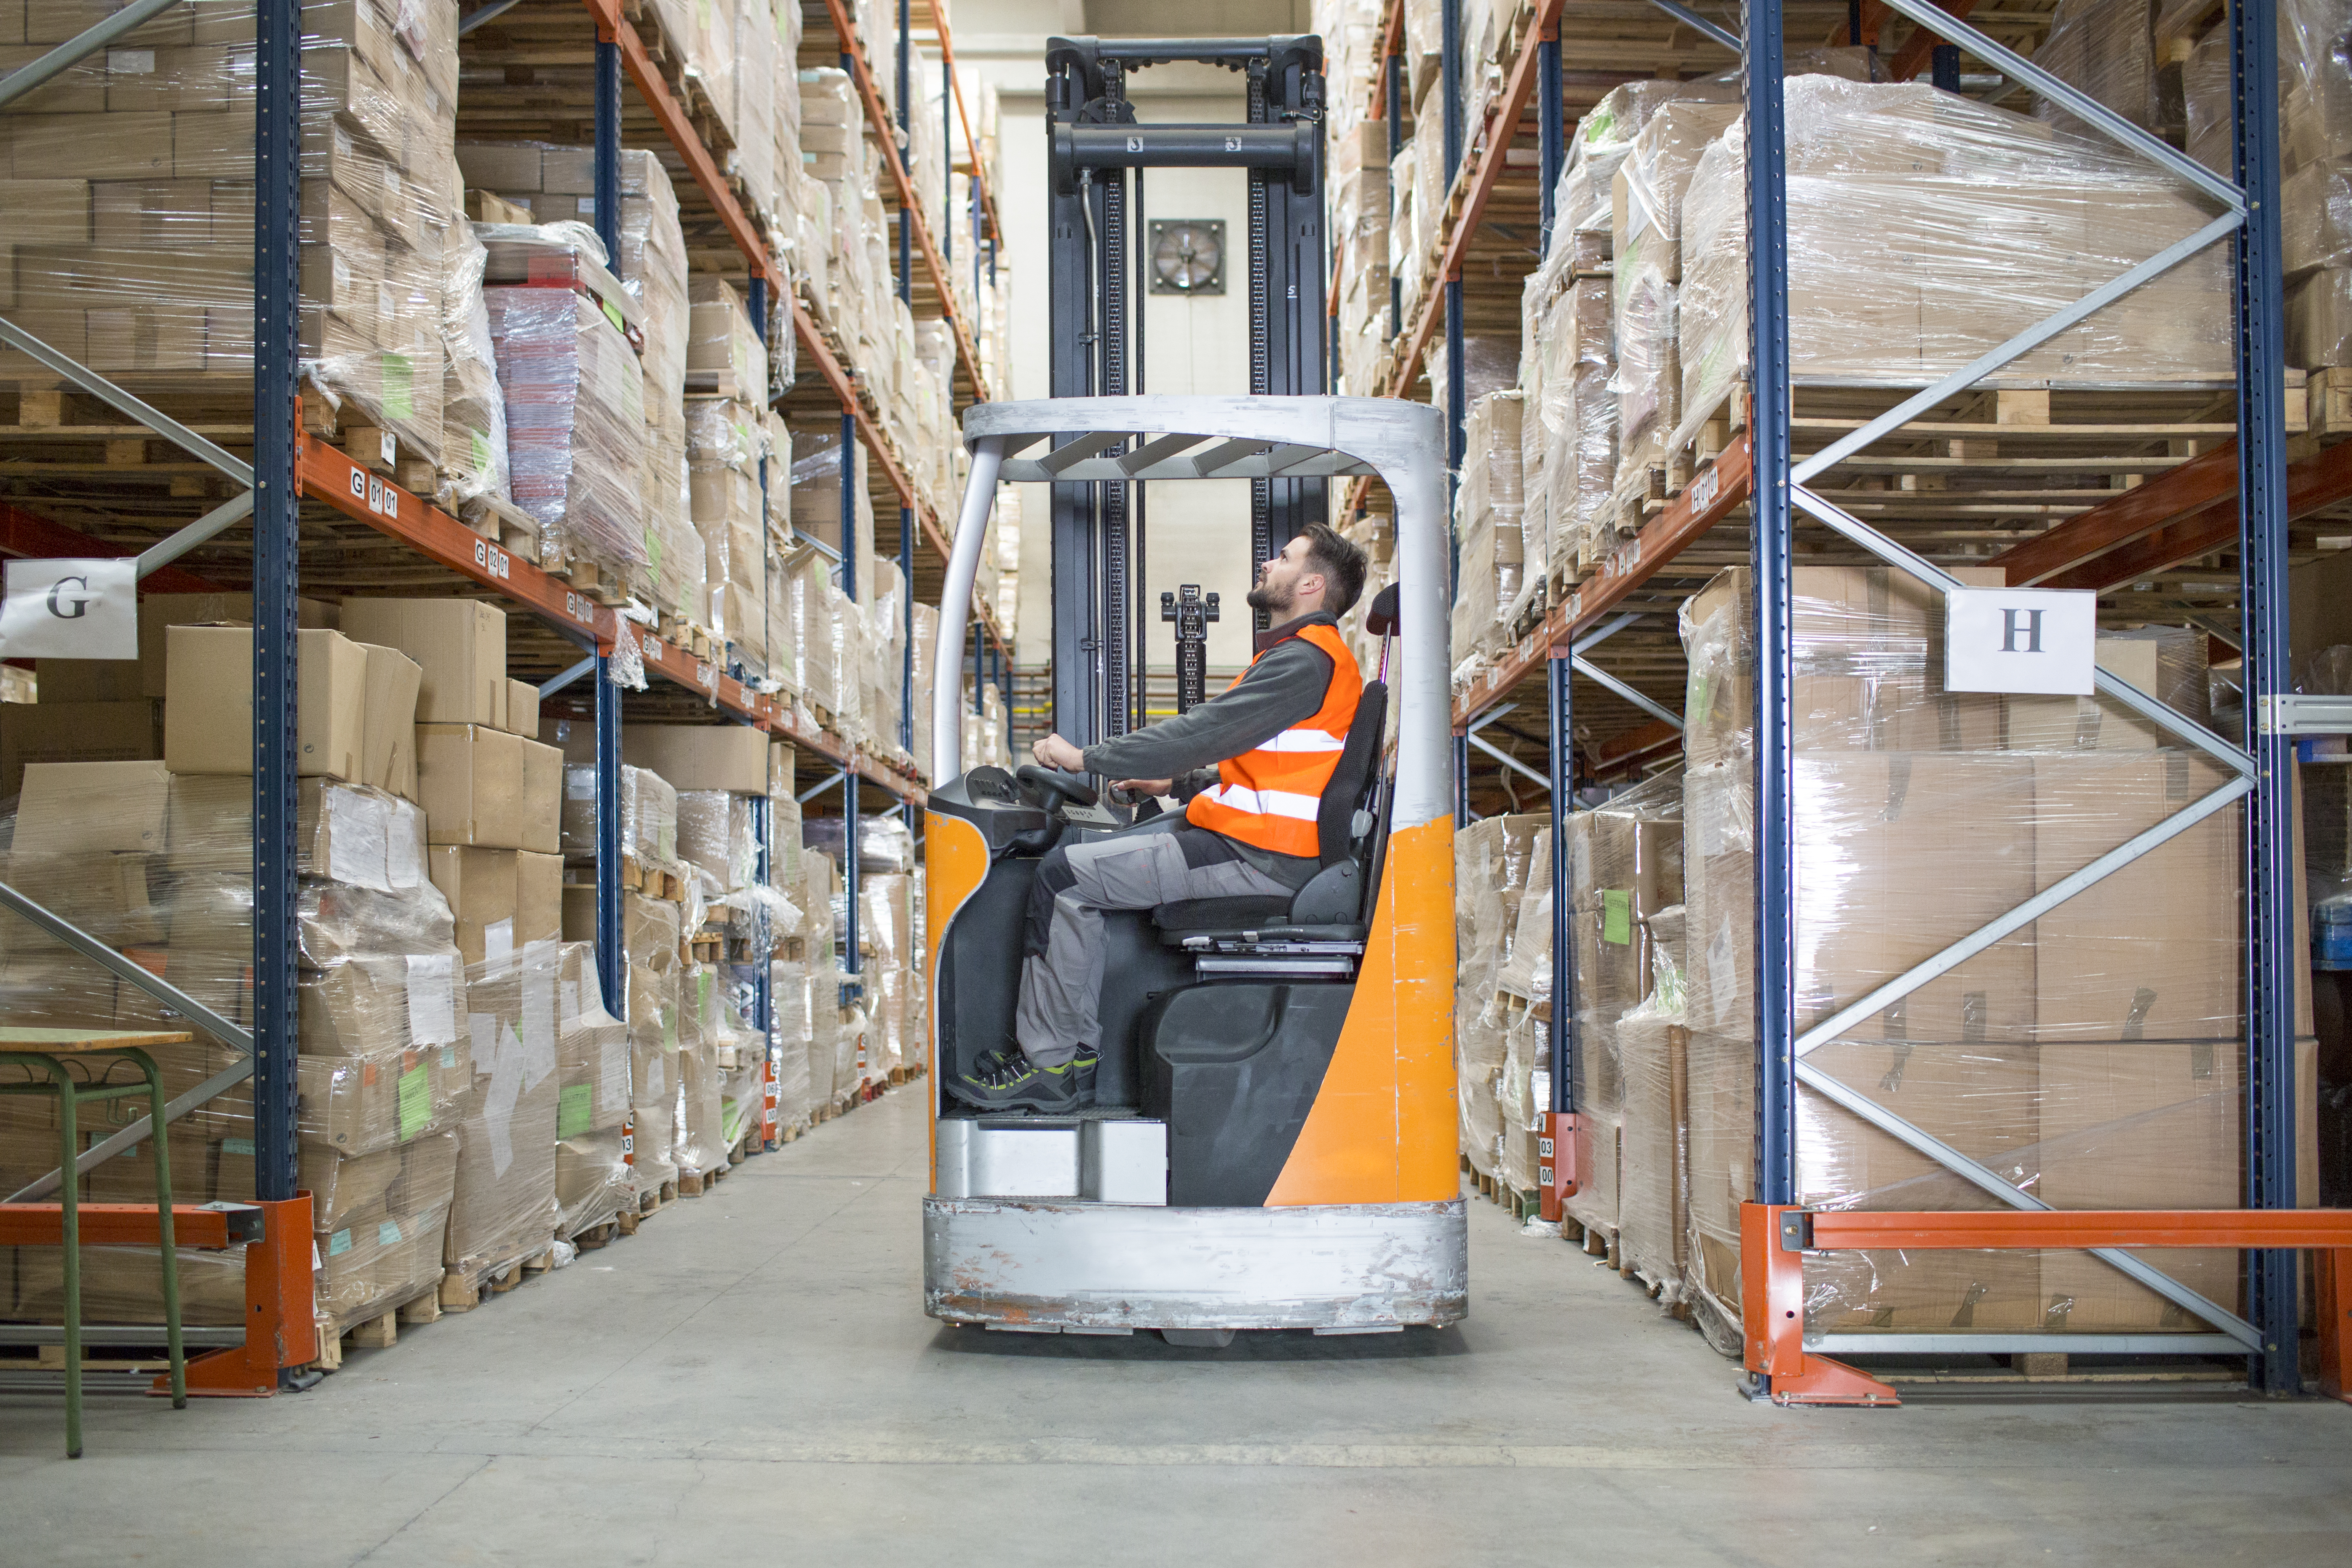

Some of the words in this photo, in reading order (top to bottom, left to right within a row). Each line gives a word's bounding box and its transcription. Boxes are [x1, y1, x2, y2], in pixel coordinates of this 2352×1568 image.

[353, 473, 363, 494] G
[372, 484, 380, 505] 01
[386, 492, 395, 512] 01
[1693, 488, 1699, 510] H
[1701, 480, 1707, 501] 01
[1711, 470, 1716, 492] 01
[476, 544, 484, 561] G
[489, 550, 497, 568] 02
[500, 556, 507, 574] 01
[1635, 541, 1640, 559] 01
[47, 576, 89, 619] G
[568, 595, 573, 610] G
[577, 601, 583, 616] 03
[586, 604, 591, 620] 01
[1997, 609, 2047, 652] H
[644, 637, 649, 651] G
[767, 1084, 774, 1094] 06
[1541, 1141, 1552, 1154] 03
[1542, 1169, 1553, 1182] 00
